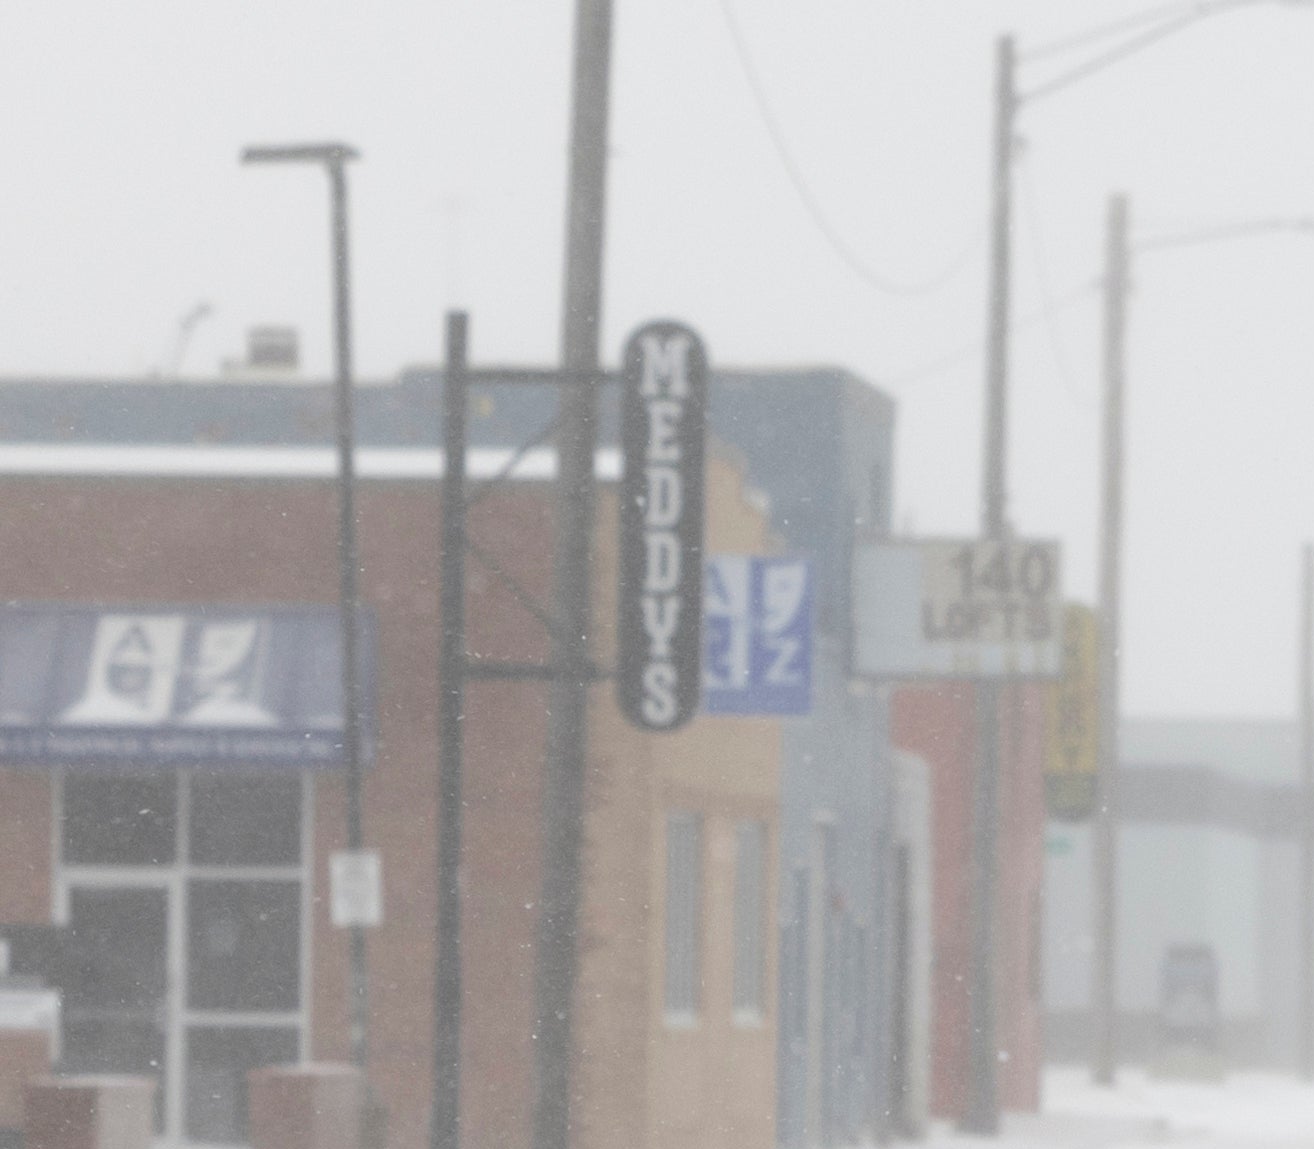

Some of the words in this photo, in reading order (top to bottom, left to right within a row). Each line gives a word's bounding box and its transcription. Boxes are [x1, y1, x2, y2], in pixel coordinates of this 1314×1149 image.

[639, 334, 692, 728] MEDDYS
[948, 544, 1052, 597] 140
[922, 602, 1052, 641] LOFTS
